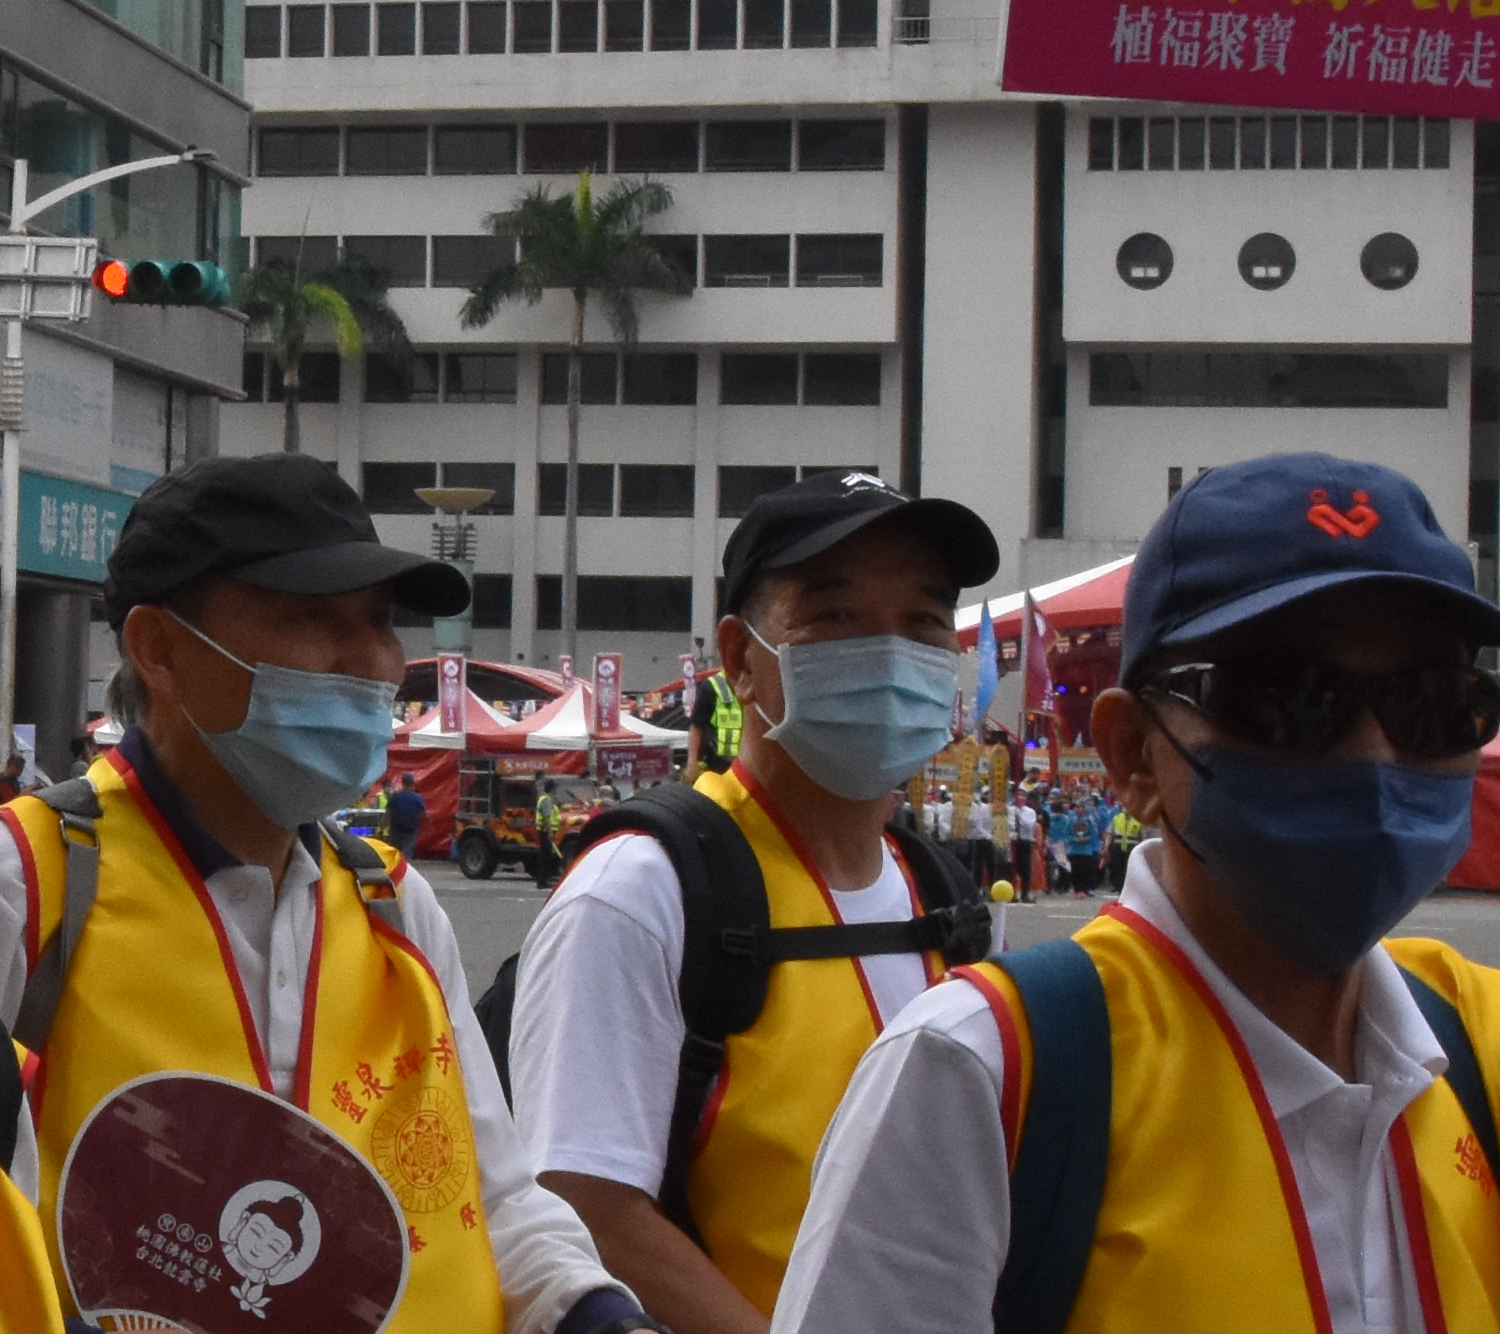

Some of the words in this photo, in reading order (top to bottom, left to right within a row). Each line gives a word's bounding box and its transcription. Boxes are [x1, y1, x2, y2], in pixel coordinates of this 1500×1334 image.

[1108, 3, 1298, 76] 植福聚寶
[1322, 19, 1499, 90] 祈福健走
[39, 494, 118, 564] 聯邦銀行
